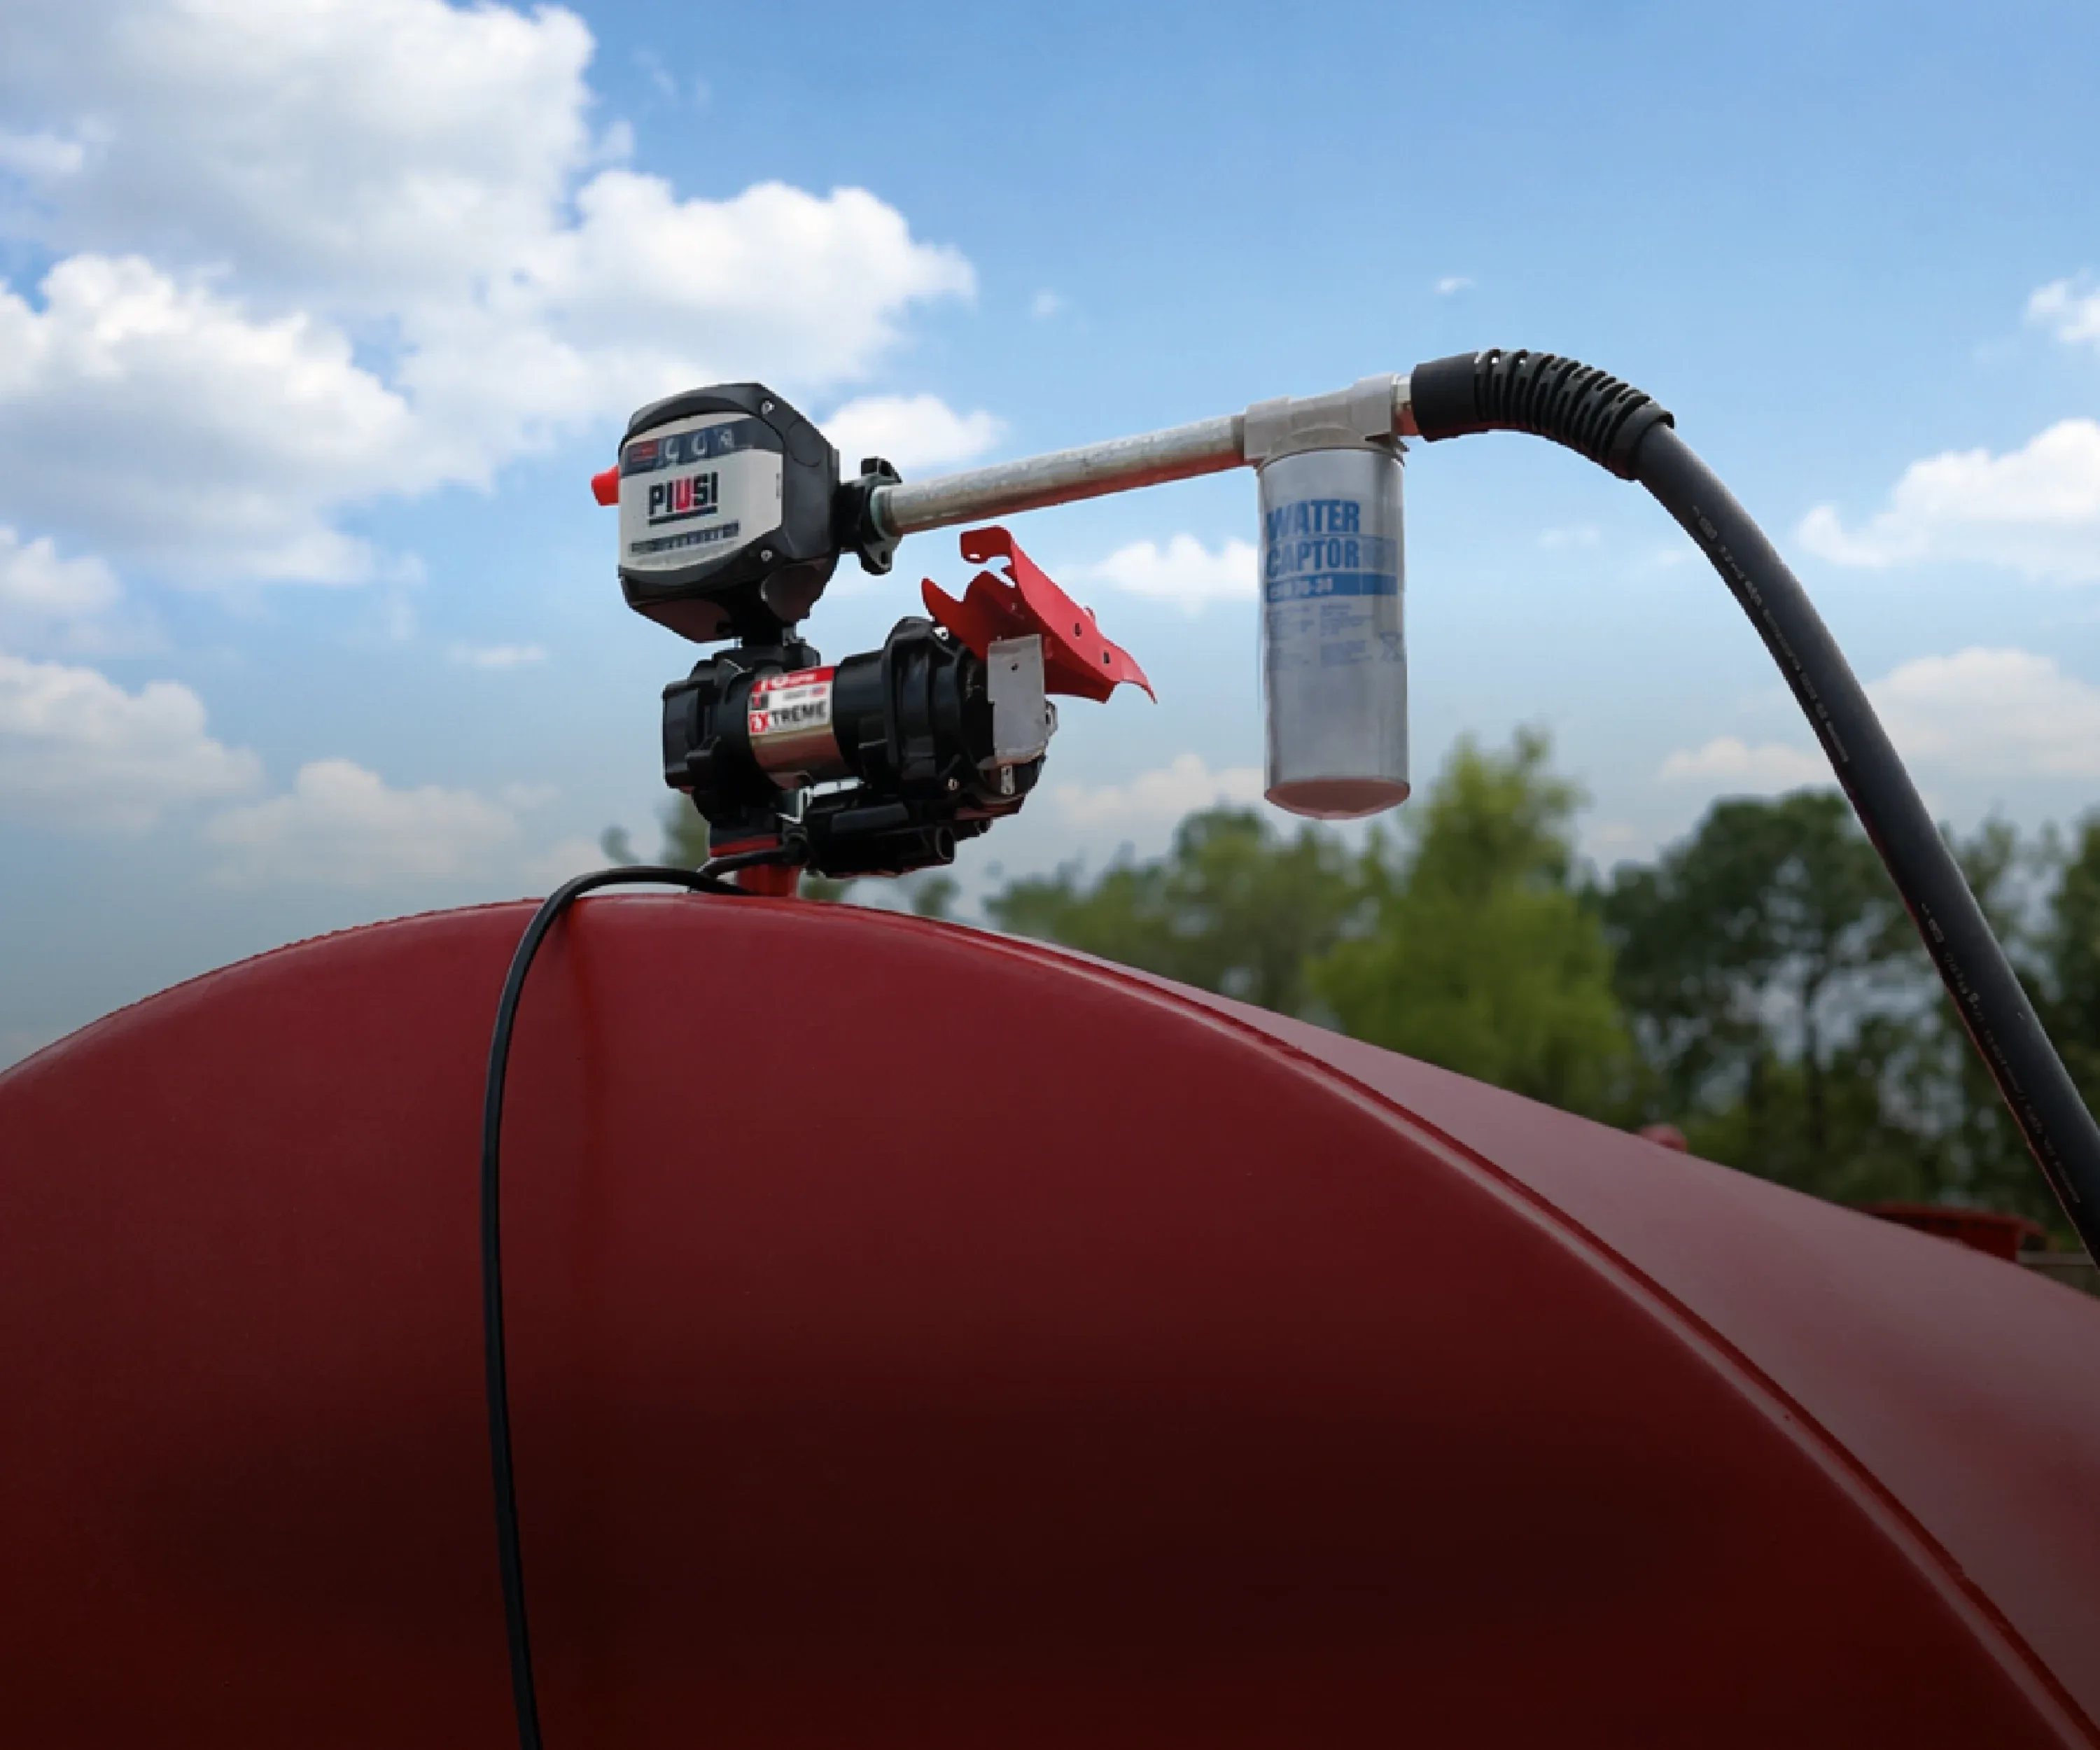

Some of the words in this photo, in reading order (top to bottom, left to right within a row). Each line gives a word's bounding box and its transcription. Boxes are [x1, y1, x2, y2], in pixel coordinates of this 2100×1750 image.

[648, 471, 718, 515] PIUSI
[1266, 499, 1360, 542] WATER
[1266, 537, 1359, 578] CAPTOR
[749, 700, 826, 734] EXTREME
